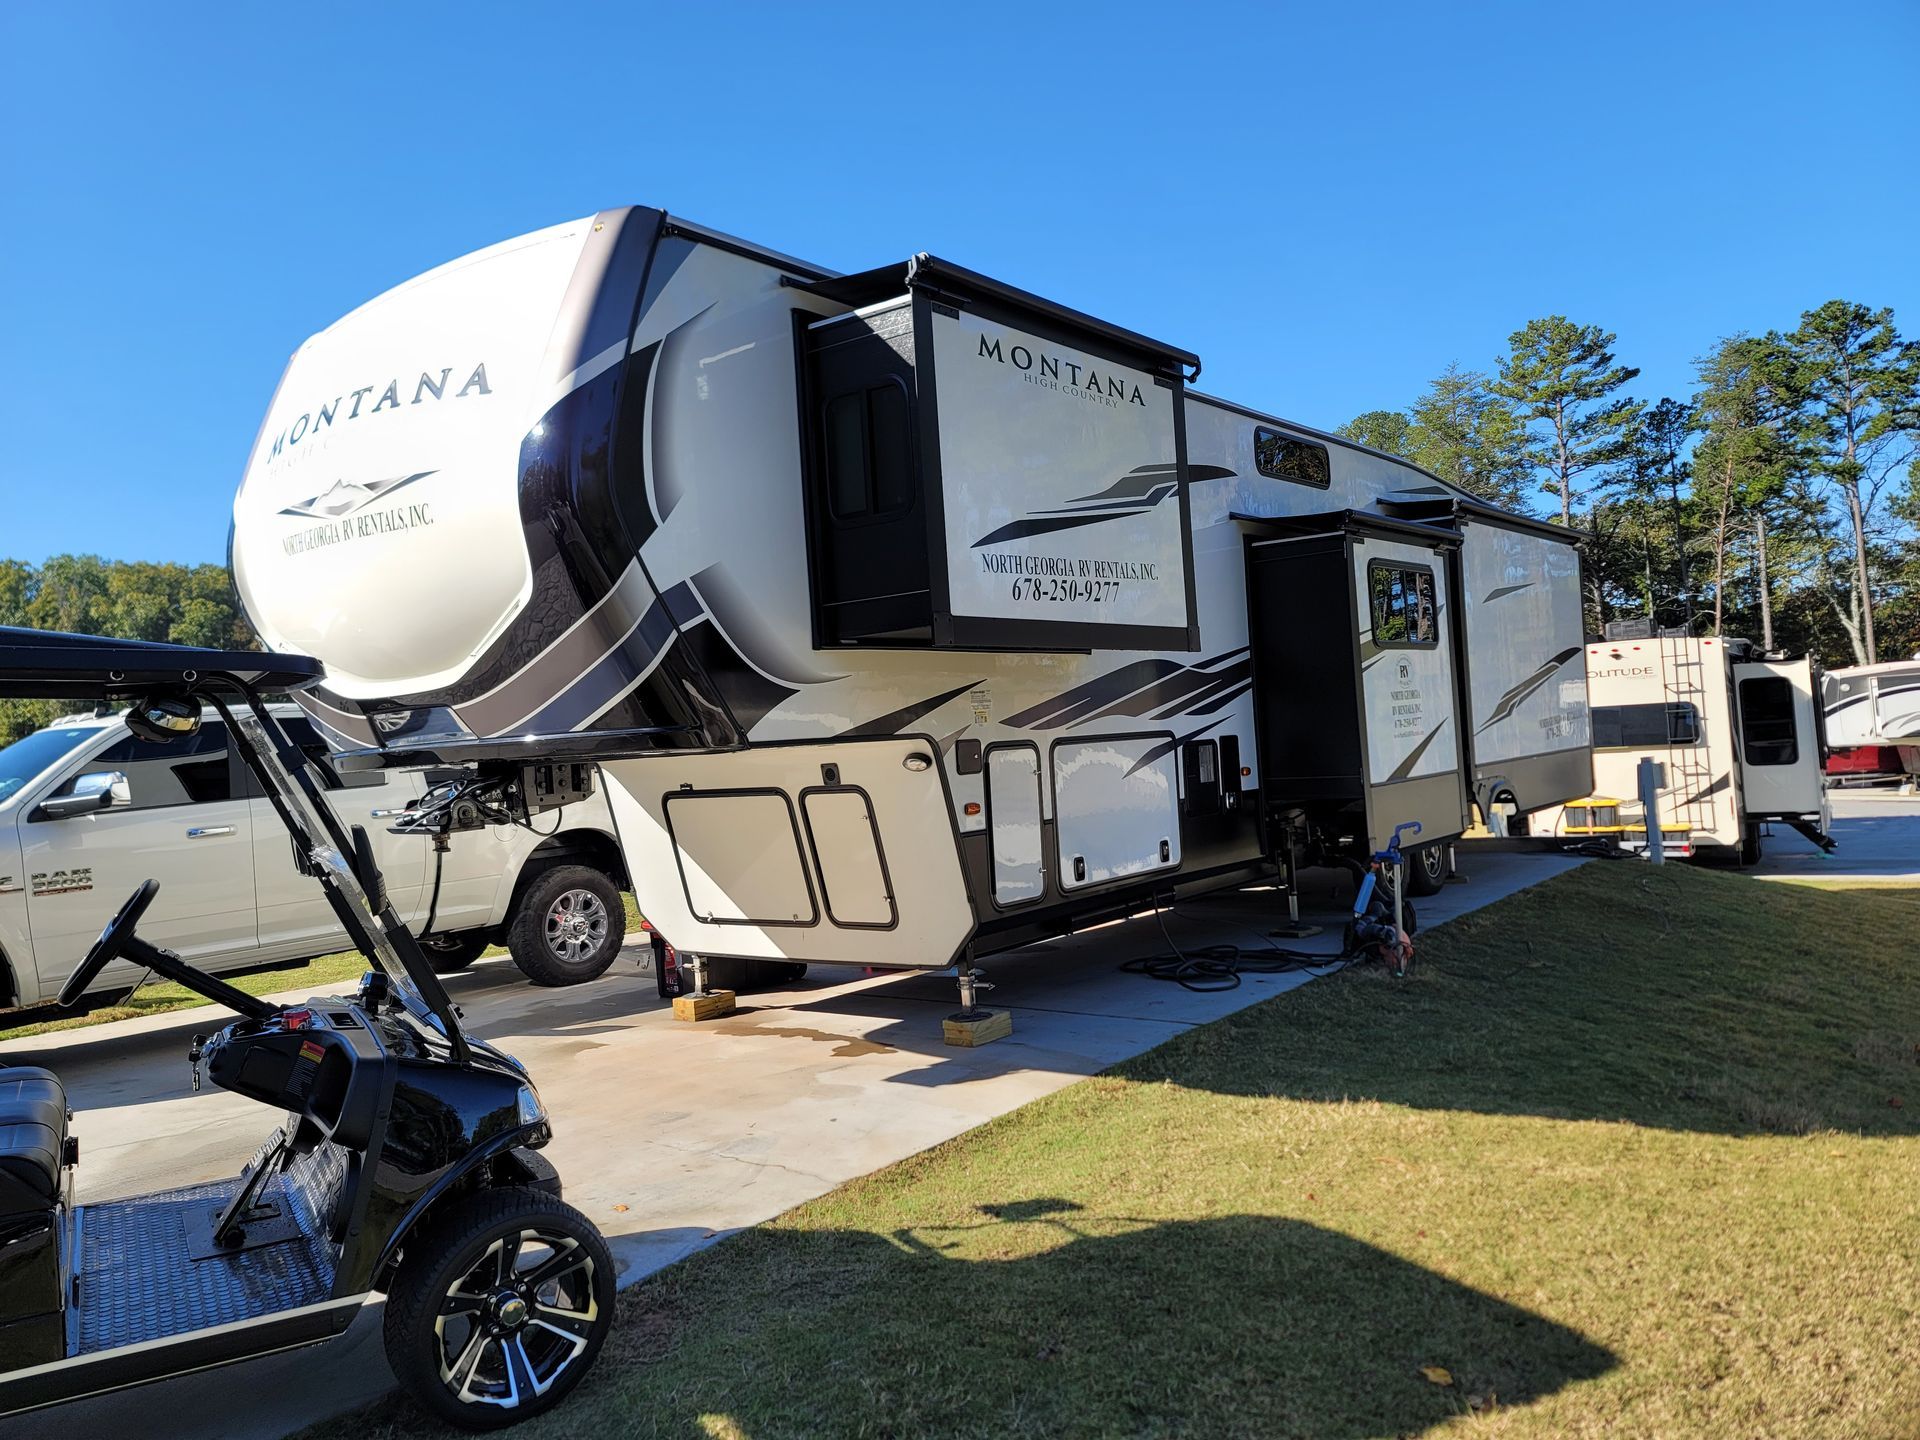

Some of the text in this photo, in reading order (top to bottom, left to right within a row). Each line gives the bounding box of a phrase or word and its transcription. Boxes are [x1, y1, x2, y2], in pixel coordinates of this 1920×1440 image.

[977, 333, 1147, 407] MONTANA
[1023, 372, 1119, 409] HIGH COUNTRY
[267, 362, 493, 465] MONTANA
[304, 522, 341, 551] GEORGIA
[342, 517, 356, 541] RV
[408, 502, 434, 528] INC.
[981, 553, 1159, 582] NORTH GEORGIA RV RENTALS, INC.
[1012, 577, 1120, 602] 678-250-9277
[1587, 667, 1654, 678] OLITUDE
